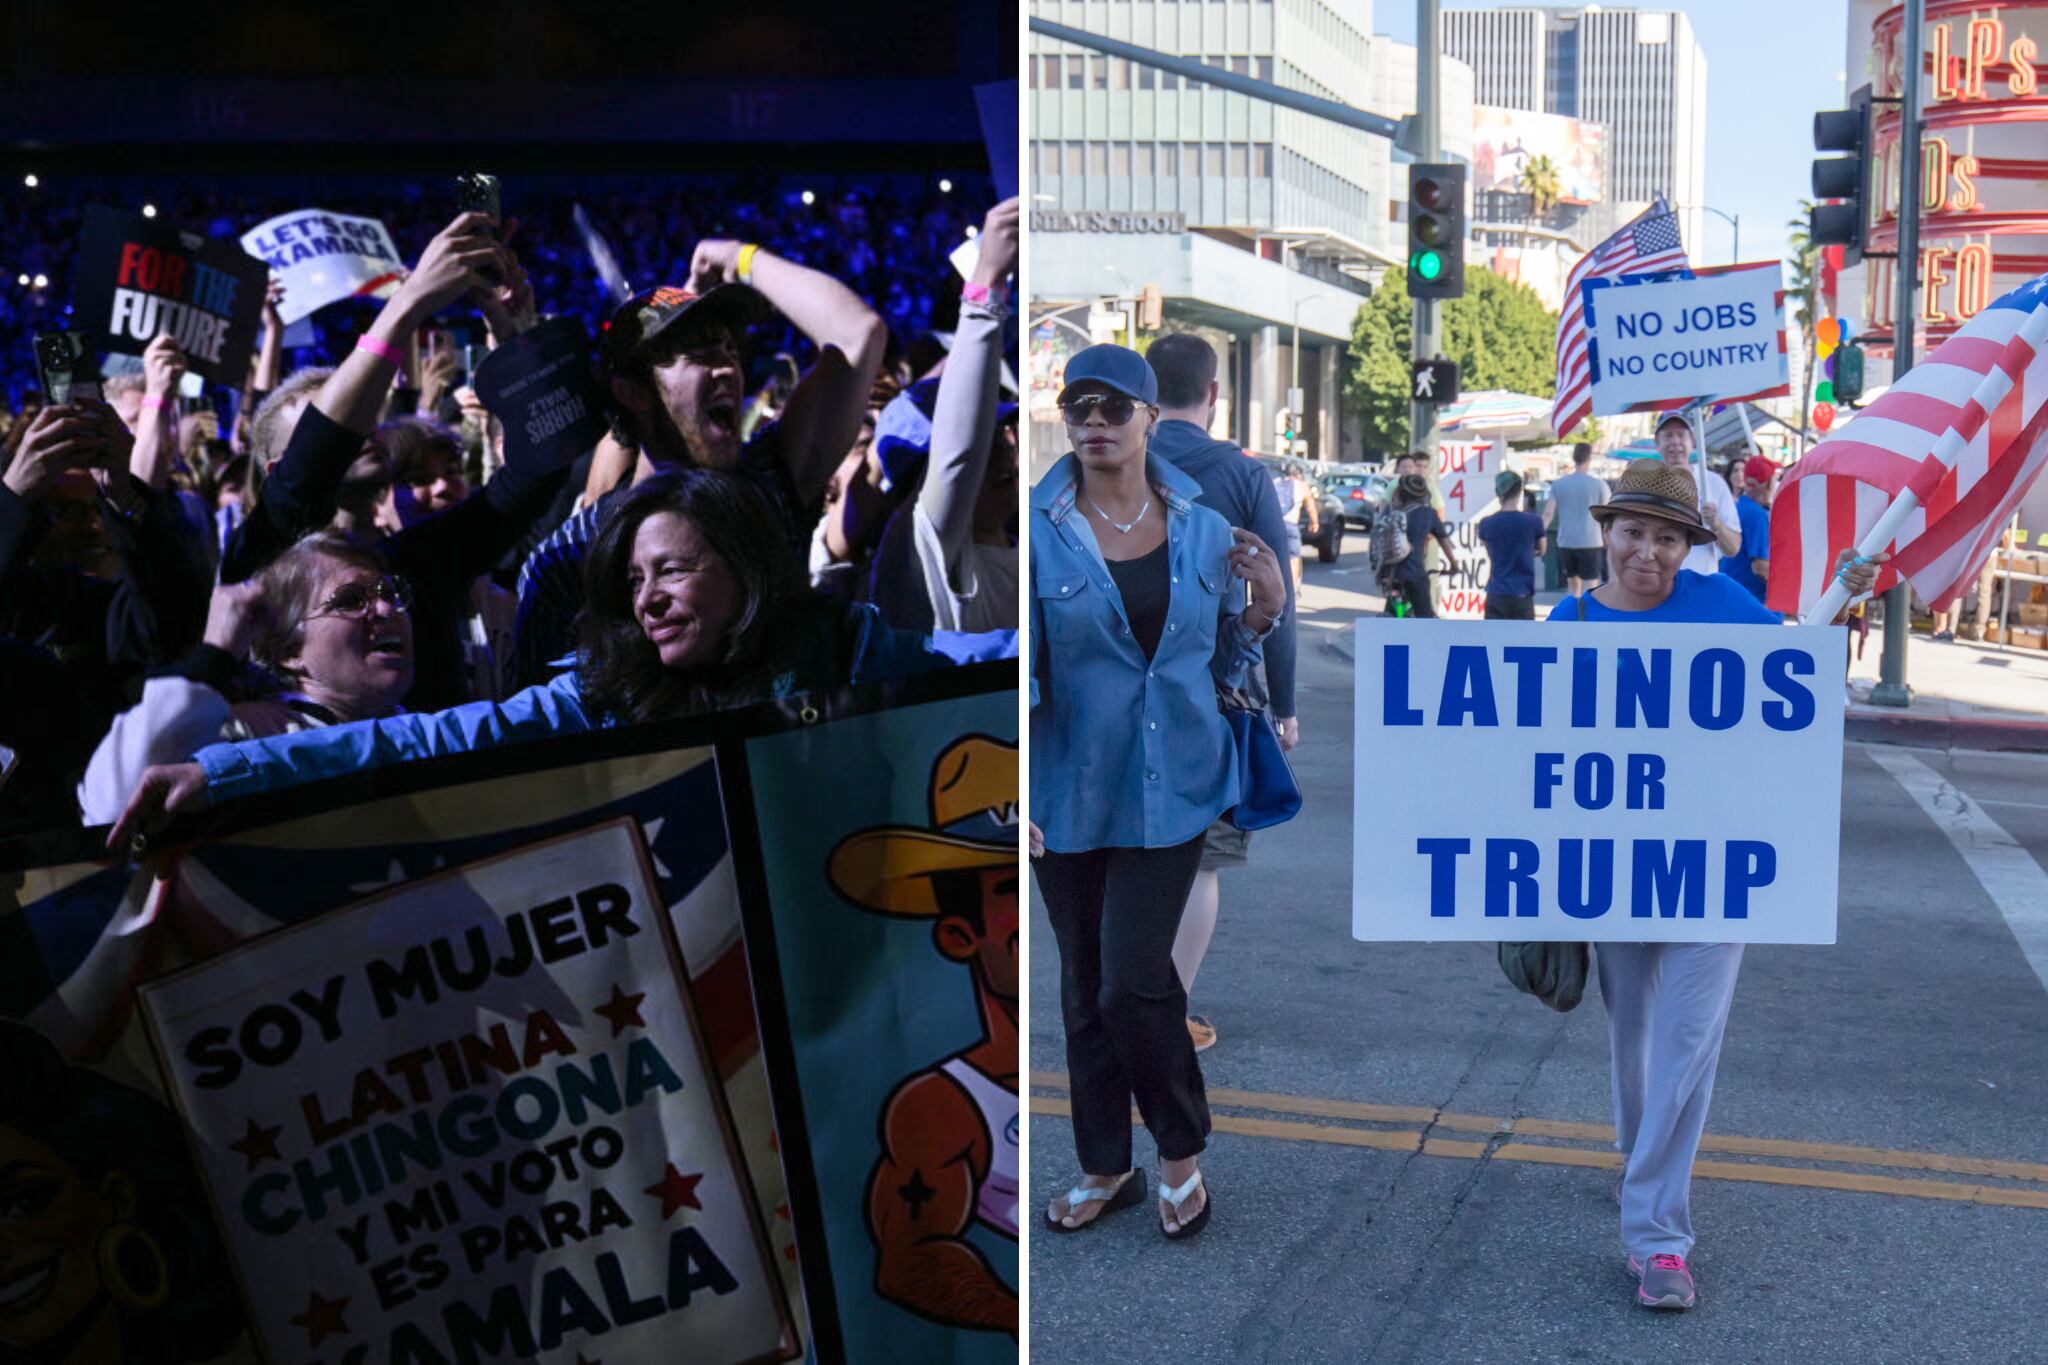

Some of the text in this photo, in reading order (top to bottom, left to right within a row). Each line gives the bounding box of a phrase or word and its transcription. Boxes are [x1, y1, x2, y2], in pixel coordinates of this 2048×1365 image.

[257, 214, 380, 254] LET'S GO
[267, 235, 395, 272] KAMALA
[1089, 212, 1185, 234] SCHOOL
[116, 240, 240, 320] FOR THE
[109, 286, 232, 366] FUTURE
[1609, 342, 1768, 376] NO COUNTRY
[1616, 302, 1756, 339] NO JOBS
[525, 393, 587, 445] HARRIS
[1449, 479, 1466, 513] 4
[1383, 645, 1816, 732] LATINOS
[1533, 752, 1666, 811] FOR
[1416, 837, 1778, 920] TRUMP
[186, 883, 640, 1089] SOY MUJER
[301, 1010, 576, 1145] LATINA
[242, 1037, 682, 1235] CHINGONA
[336, 1127, 623, 1265] Y MI VOTO
[371, 1188, 630, 1308] ES PARA
[311, 1226, 738, 1365] AMALA
